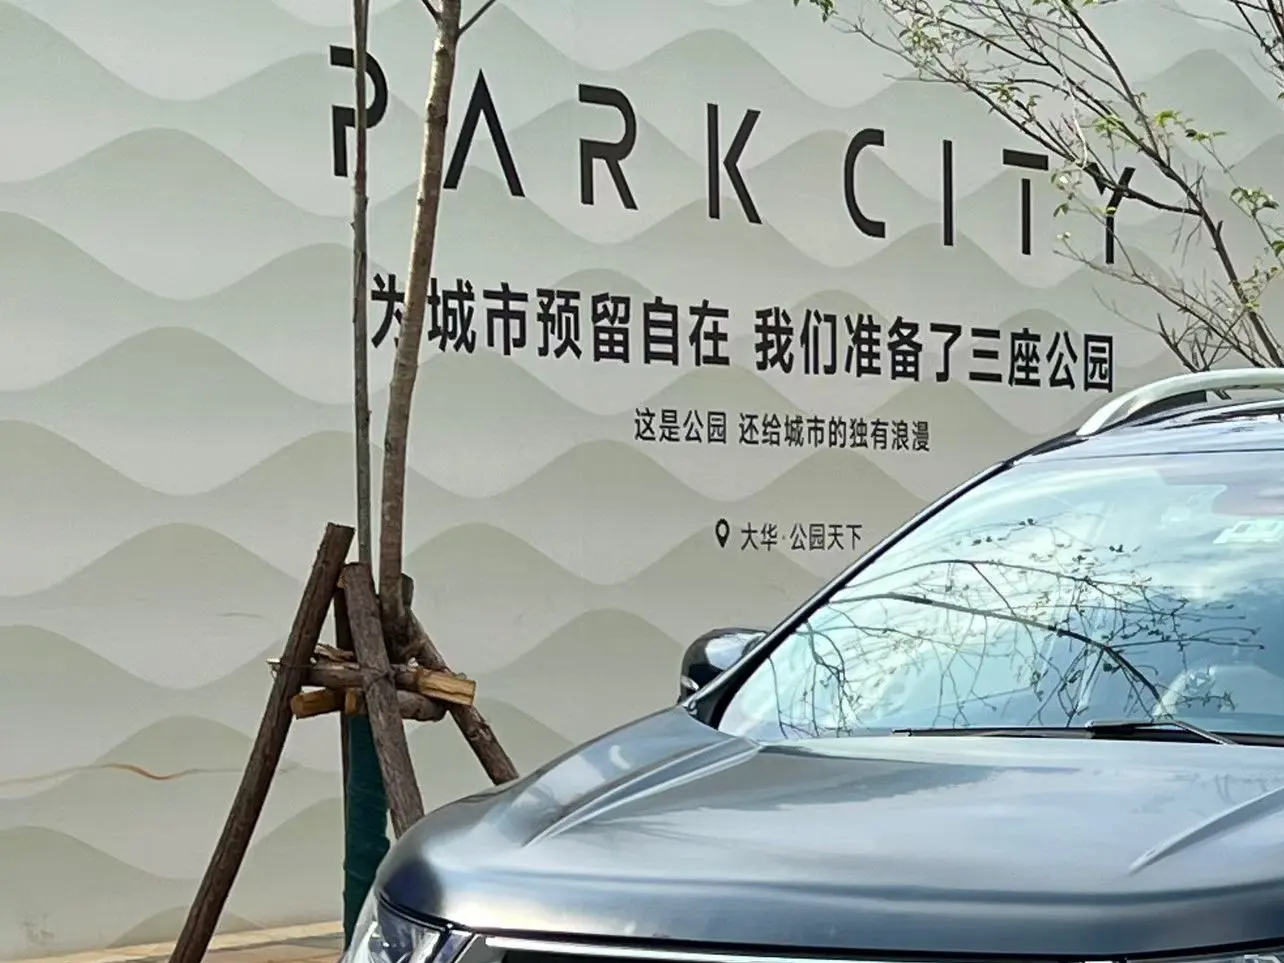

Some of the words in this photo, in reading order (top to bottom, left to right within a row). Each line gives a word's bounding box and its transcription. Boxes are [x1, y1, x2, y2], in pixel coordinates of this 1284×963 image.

[330, 45, 763, 224] PARK
[842, 128, 1136, 265] CITY
[371, 273, 731, 367] 为城市预留自在
[754, 306, 1114, 393] 我们准备了三座公园
[634, 408, 727, 444] 这是公园
[738, 412, 931, 452] 还给城市的独有浪漫
[740, 522, 863, 552] 大华·公园天下
